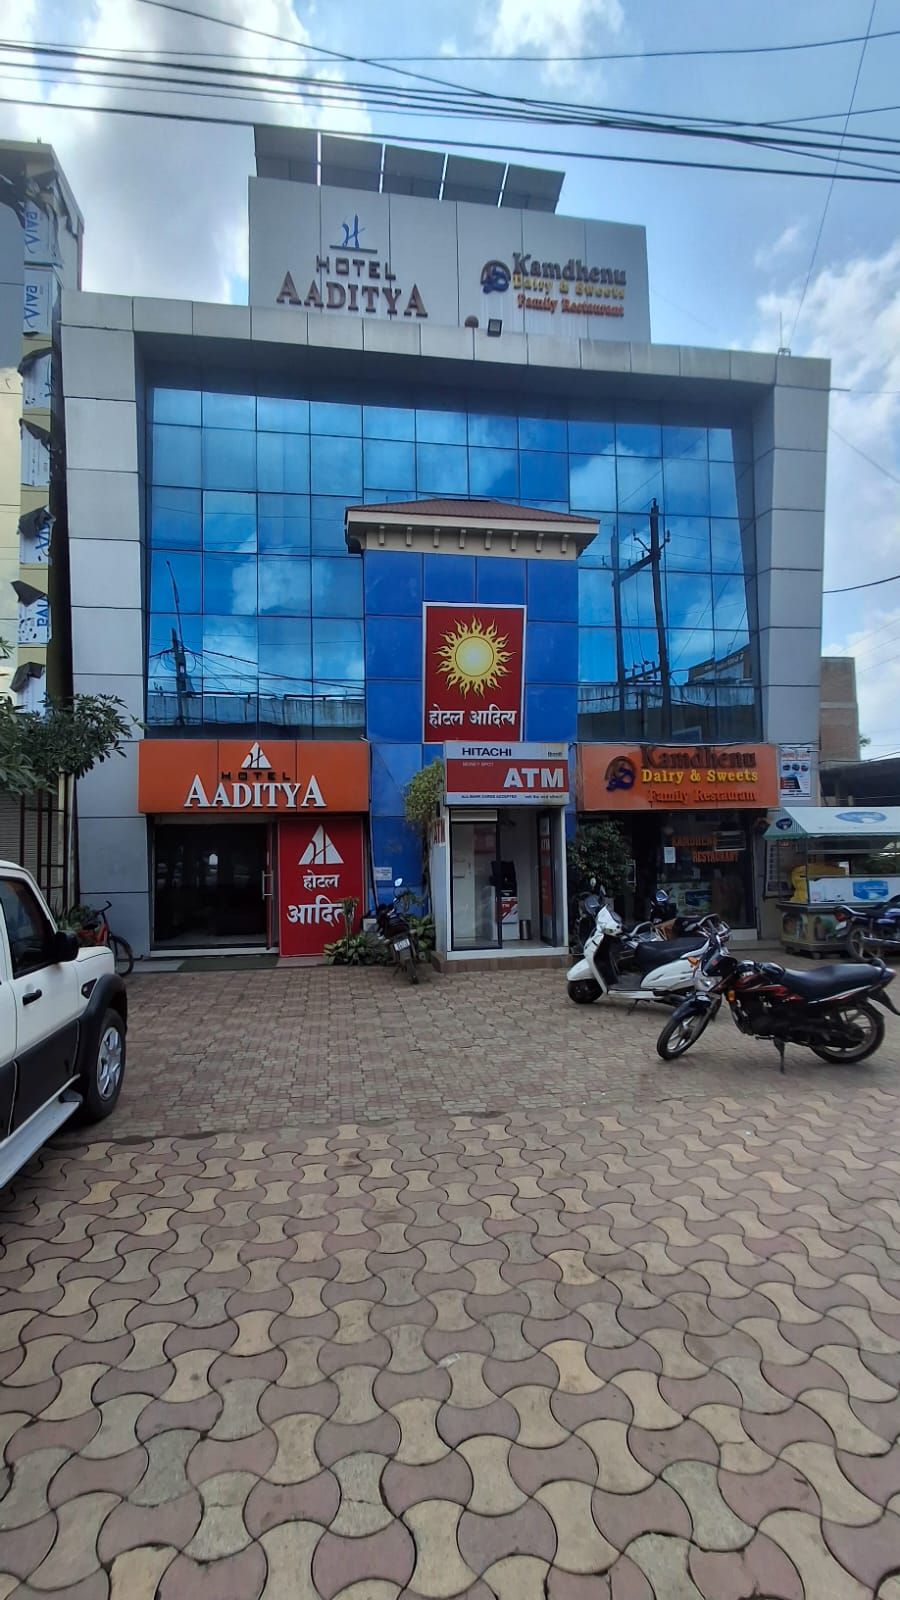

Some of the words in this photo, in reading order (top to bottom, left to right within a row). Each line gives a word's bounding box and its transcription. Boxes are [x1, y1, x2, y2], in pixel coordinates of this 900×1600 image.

[316, 254, 396, 281] HOTEL
[512, 251, 627, 286] Kamdhenu
[276, 270, 429, 318] AADITYA
[512, 273, 553, 296] Dairy
[559, 281, 569, 295] &
[575, 283, 625, 300] Sweets
[517, 292, 558, 314] Family
[561, 298, 625, 317] Restaurant
[428, 703, 466, 728] होटल
[469, 703, 518, 728] आदित्य
[462, 747, 512, 757] HITACHI
[640, 745, 757, 769] Kamdhenu
[220, 771, 291, 782] HOTEL
[503, 767, 564, 788] ATM
[641, 770, 684, 785] Dairy
[690, 769, 701, 782] &
[707, 769, 759, 782] Sweets
[183, 773, 328, 809] AADITYA
[647, 789, 688, 806] Family
[302, 869, 341, 891] होटल
